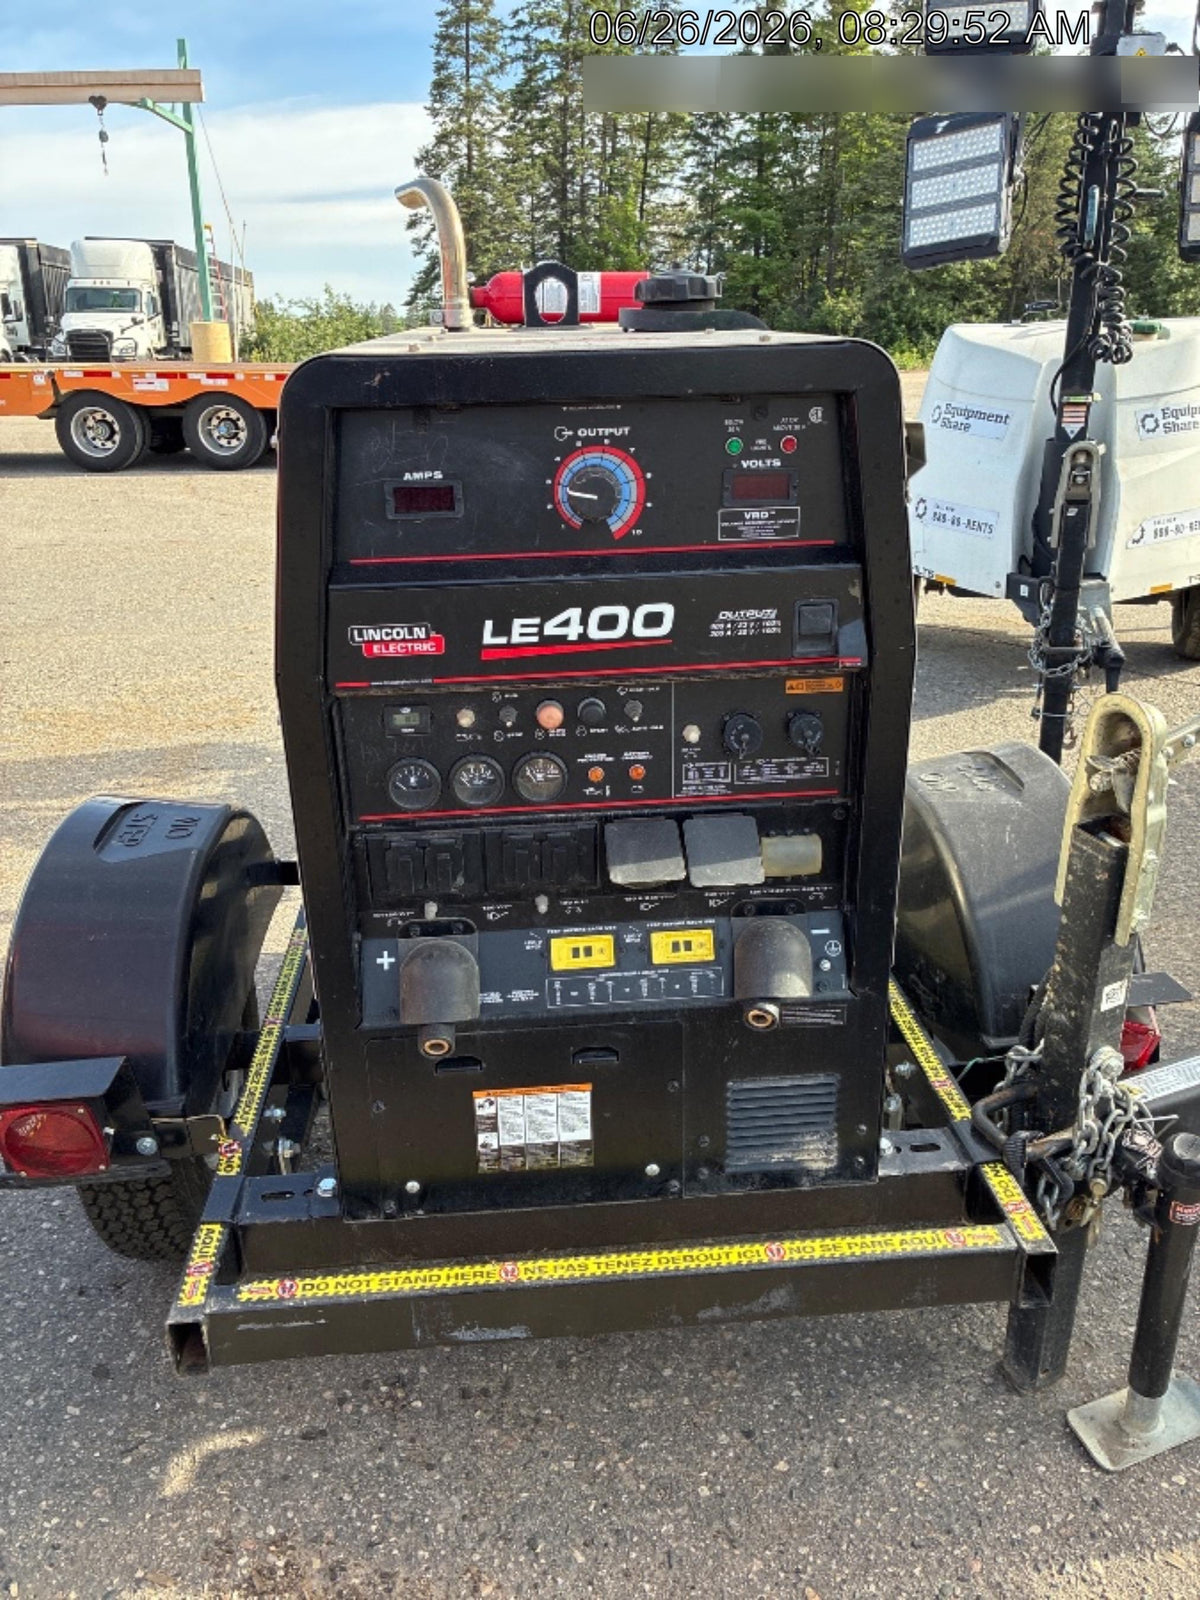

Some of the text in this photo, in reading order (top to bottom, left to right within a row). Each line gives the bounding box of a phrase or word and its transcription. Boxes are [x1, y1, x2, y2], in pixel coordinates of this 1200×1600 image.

[944, 403, 1010, 426] Equipment
[1161, 404, 1200, 422] Equip
[577, 427, 630, 436] OUTPUT
[941, 417, 971, 432] Share
[740, 458, 781, 468] VOLTS
[402, 471, 443, 481] AMPS
[744, 511, 769, 519] VRD
[482, 603, 675, 645] LE400
[353, 627, 427, 642] LINCOLN
[373, 642, 437, 654] ELECTRIC
[788, 1244, 814, 1257] NO
[822, 1243, 844, 1254] SE
[848, 1238, 894, 1252] PARE
[523, 1249, 760, 1276] NE PAS TENEZ DEBOUT ICI
[302, 1269, 496, 1293] DO NOT STAND HERE
